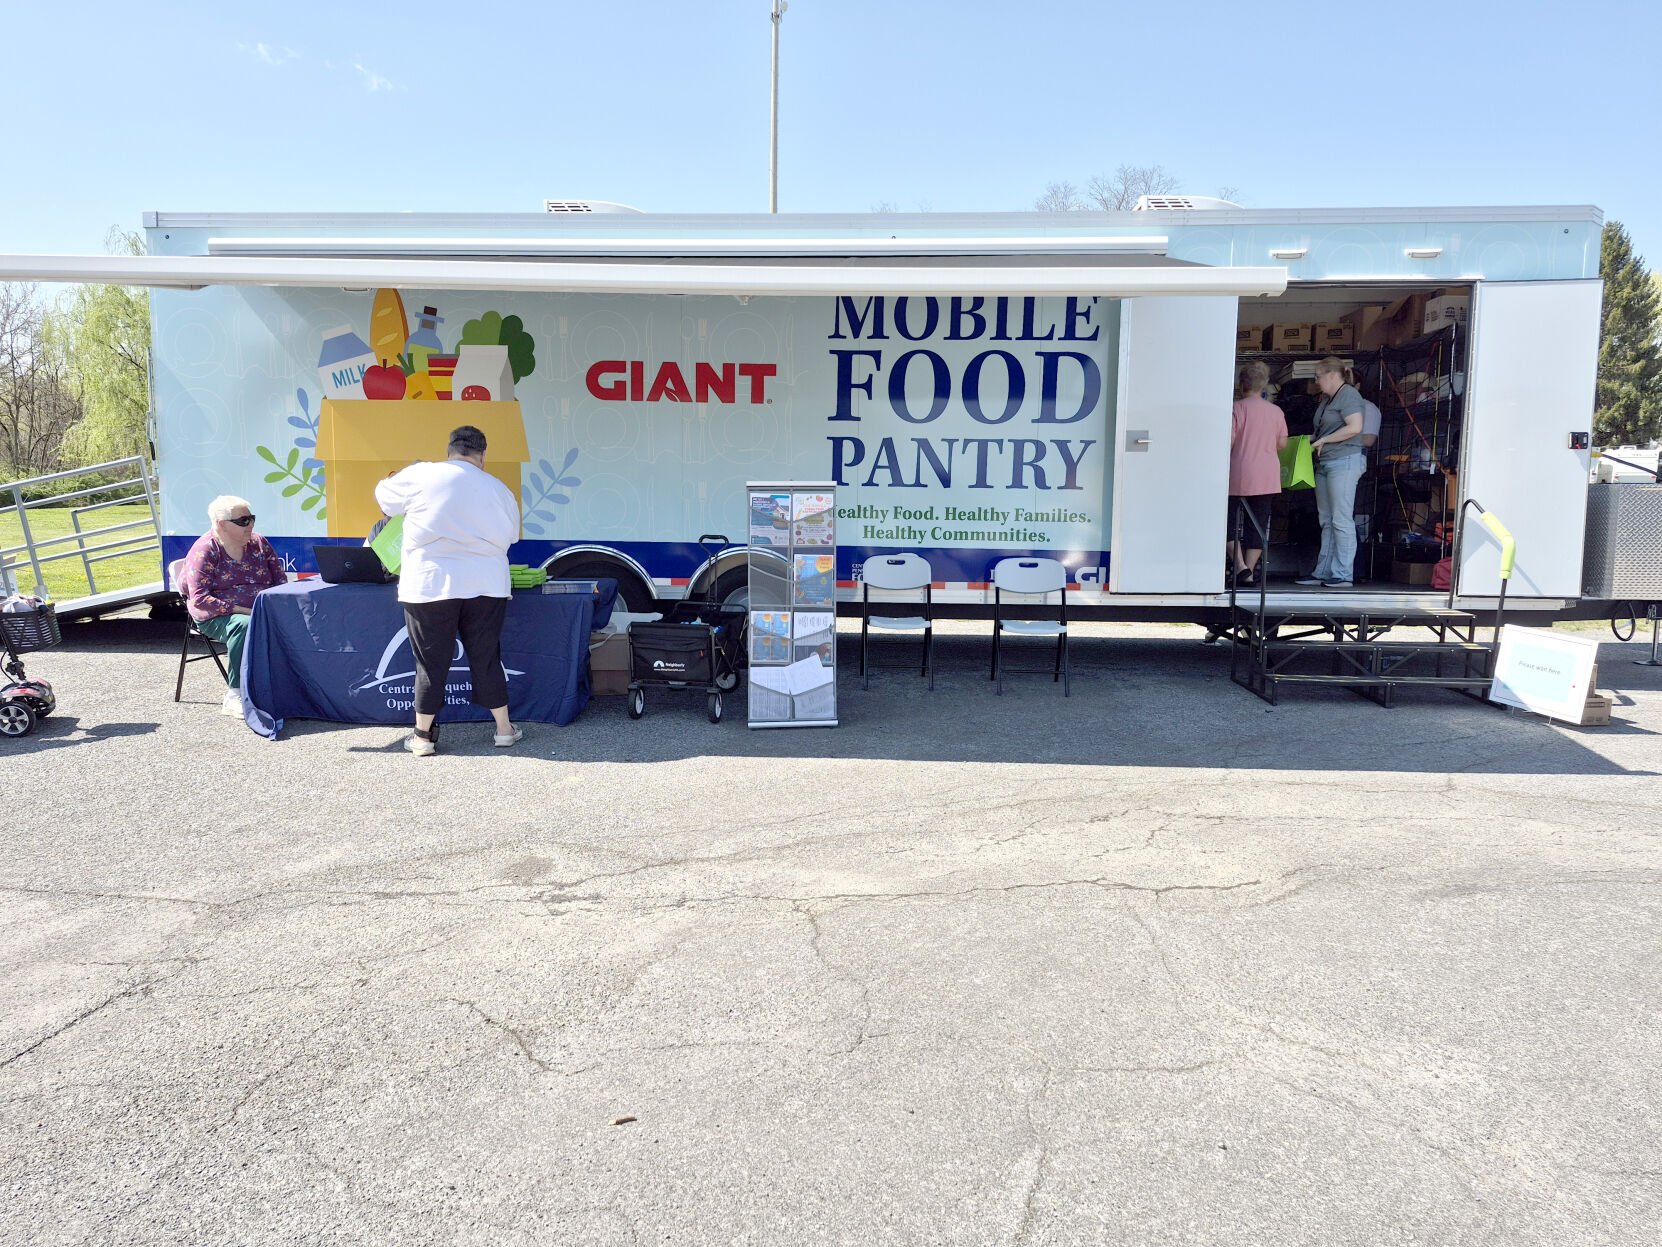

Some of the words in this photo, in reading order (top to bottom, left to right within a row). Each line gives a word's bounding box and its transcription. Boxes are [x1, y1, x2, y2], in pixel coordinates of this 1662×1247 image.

[827, 296, 1100, 341] MOBILE
[331, 363, 367, 389] MILK
[585, 360, 777, 404] GIANT
[827, 349, 1102, 425] FOOD
[826, 436, 1097, 491] PANTRY
[836, 504, 889, 524] ealthy
[892, 505, 940, 521] Food.
[944, 507, 1010, 525] Healthy
[1014, 508, 1092, 524] Families.
[862, 525, 927, 544] Healthy
[930, 526, 1051, 543] Communities.
